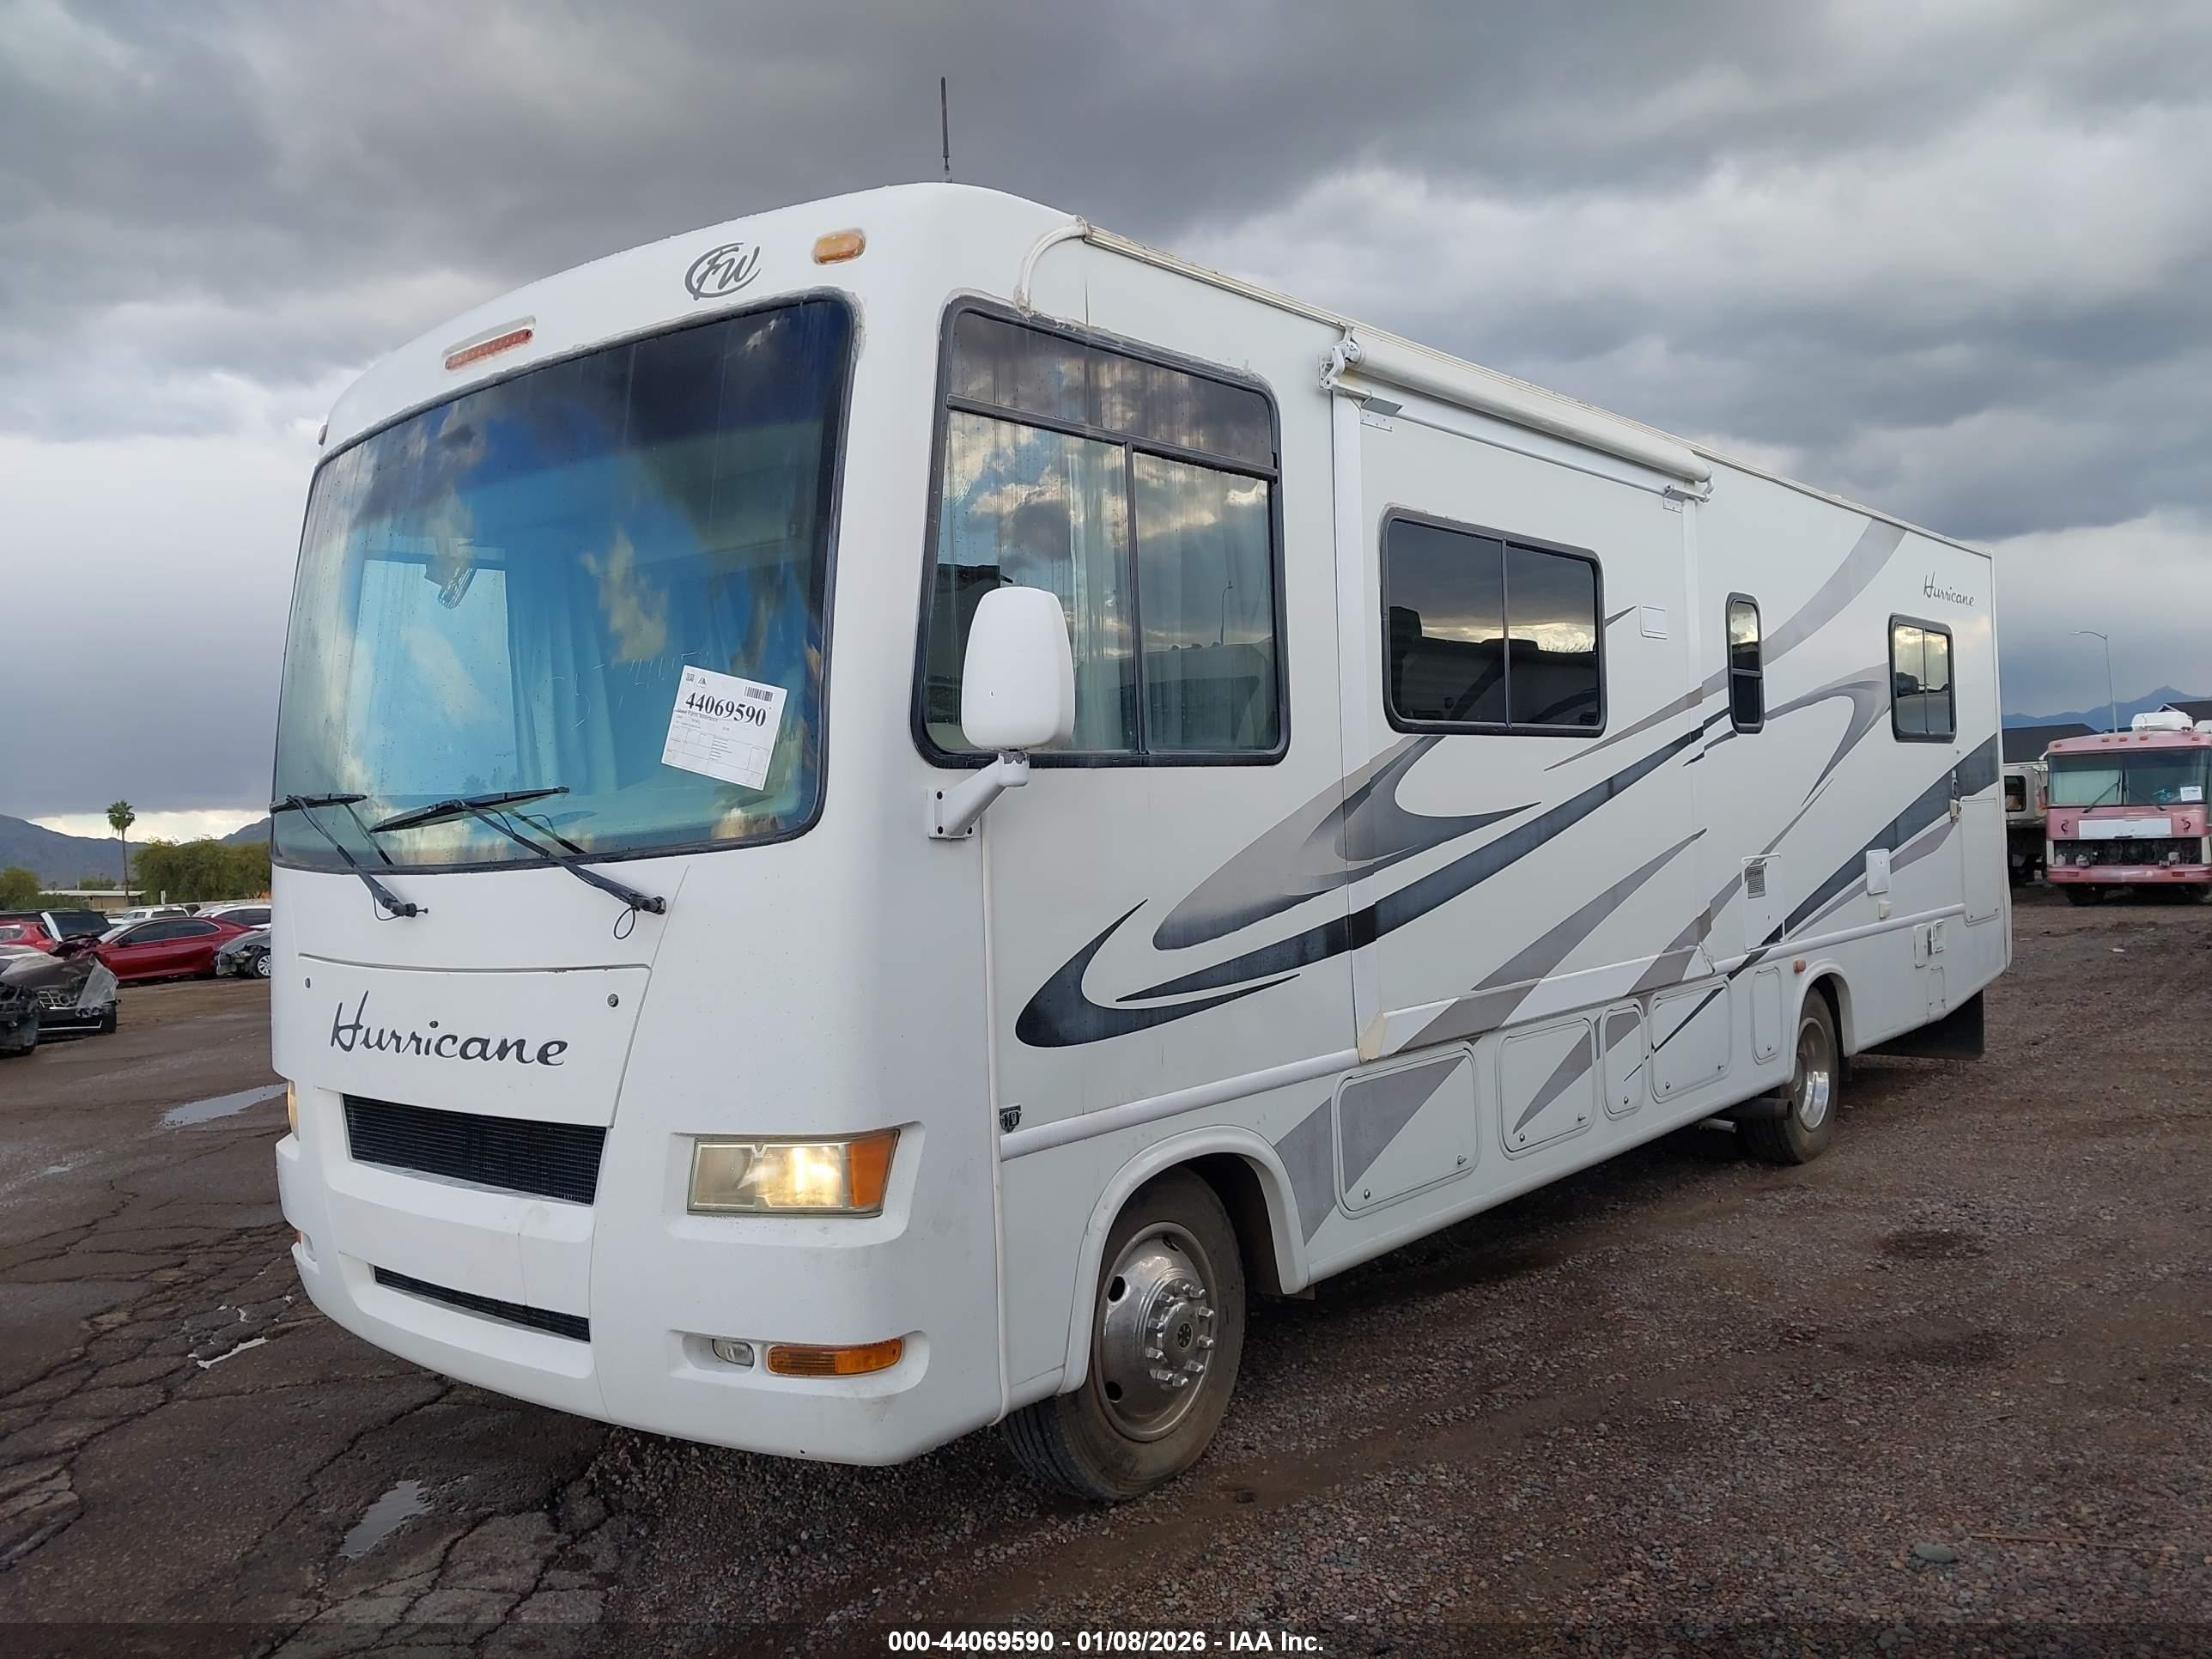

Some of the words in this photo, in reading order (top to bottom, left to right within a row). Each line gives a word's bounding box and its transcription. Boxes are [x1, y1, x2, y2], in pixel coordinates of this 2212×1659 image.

[1923, 571, 1974, 606] Hurricane
[685, 692, 767, 727] 44069590
[331, 990, 568, 1066] Hurricane
